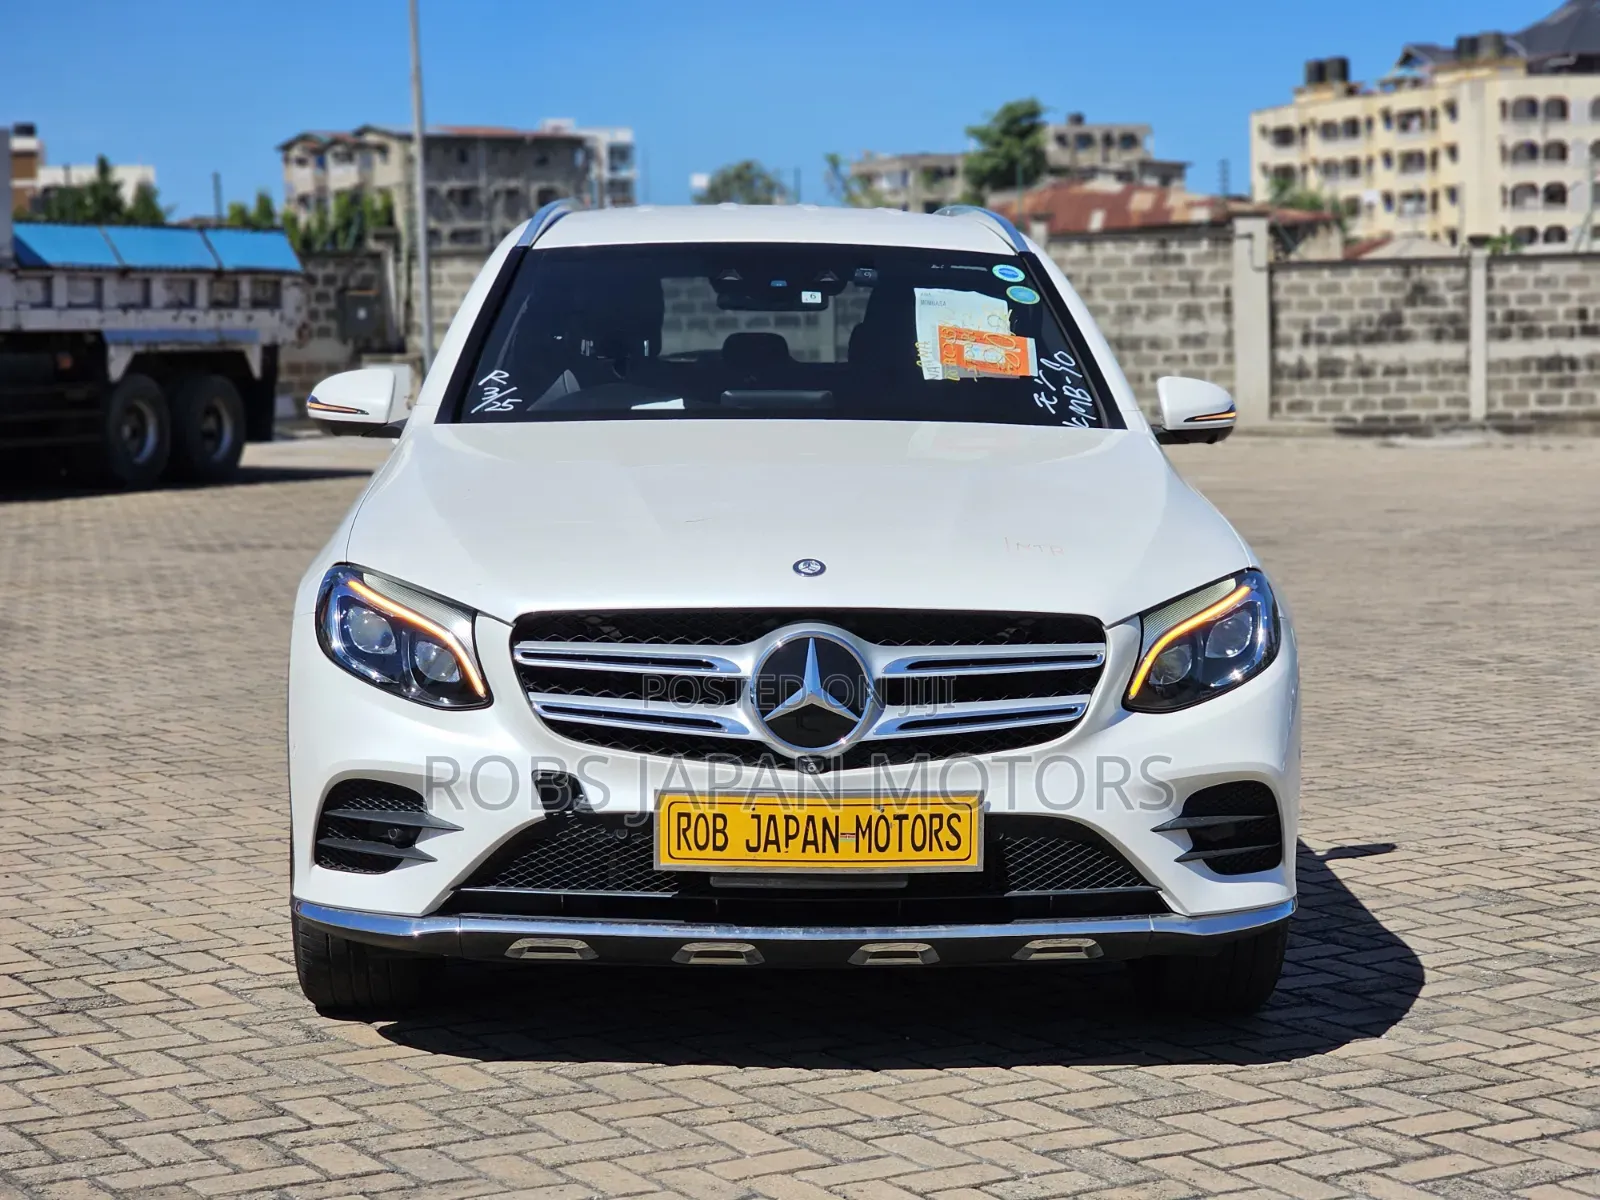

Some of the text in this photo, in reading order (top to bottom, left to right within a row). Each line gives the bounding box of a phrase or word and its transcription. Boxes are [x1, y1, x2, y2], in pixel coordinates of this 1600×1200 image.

[478, 369, 510, 386] R
[676, 811, 962, 854] ROB JAPAN MOTORS
